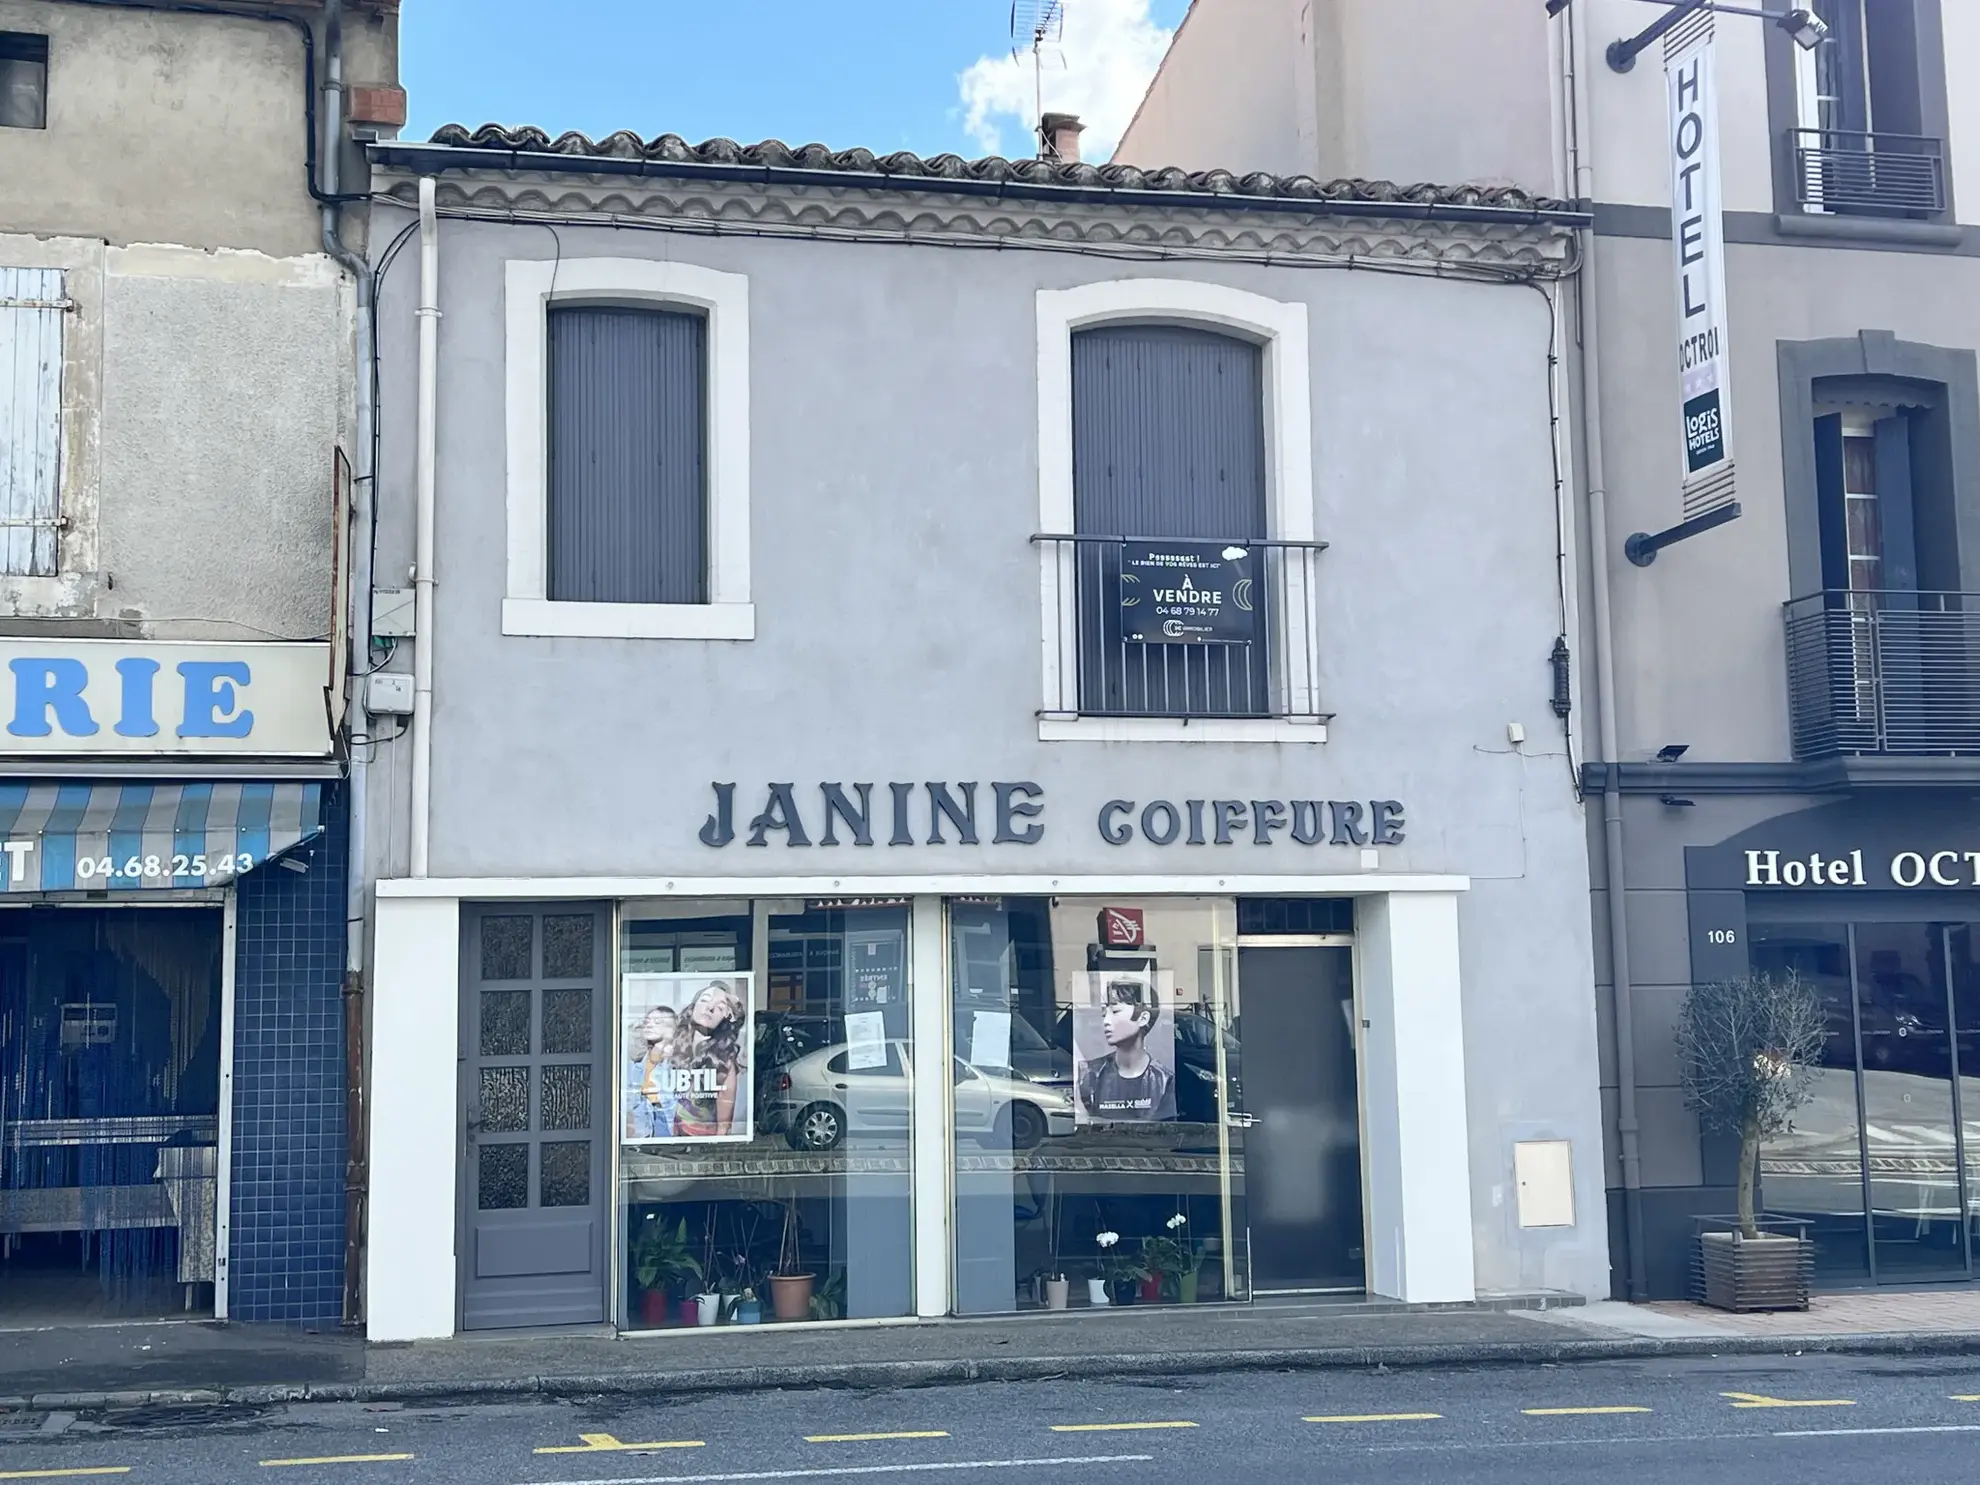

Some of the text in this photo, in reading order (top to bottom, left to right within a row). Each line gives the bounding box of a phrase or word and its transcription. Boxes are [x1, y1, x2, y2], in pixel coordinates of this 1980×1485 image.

[1675, 58, 1706, 318] HOTEL
[1679, 327, 1720, 373] OCTROI
[1686, 407, 1719, 438] Logis
[1688, 427, 1720, 451] HOTELS
[1153, 589, 1222, 604] VENDRE
[1182, 573, 1194, 590] À
[1156, 606, 1220, 617] 04 68 79 14 77
[6, 657, 255, 738] RIE
[699, 780, 1406, 848] JANINE COIFFURE
[0, 841, 34, 881] T
[77, 853, 254, 879] 04.68.25.43
[1744, 849, 1980, 888] Hotel OCT
[1707, 929, 1736, 944] 106
